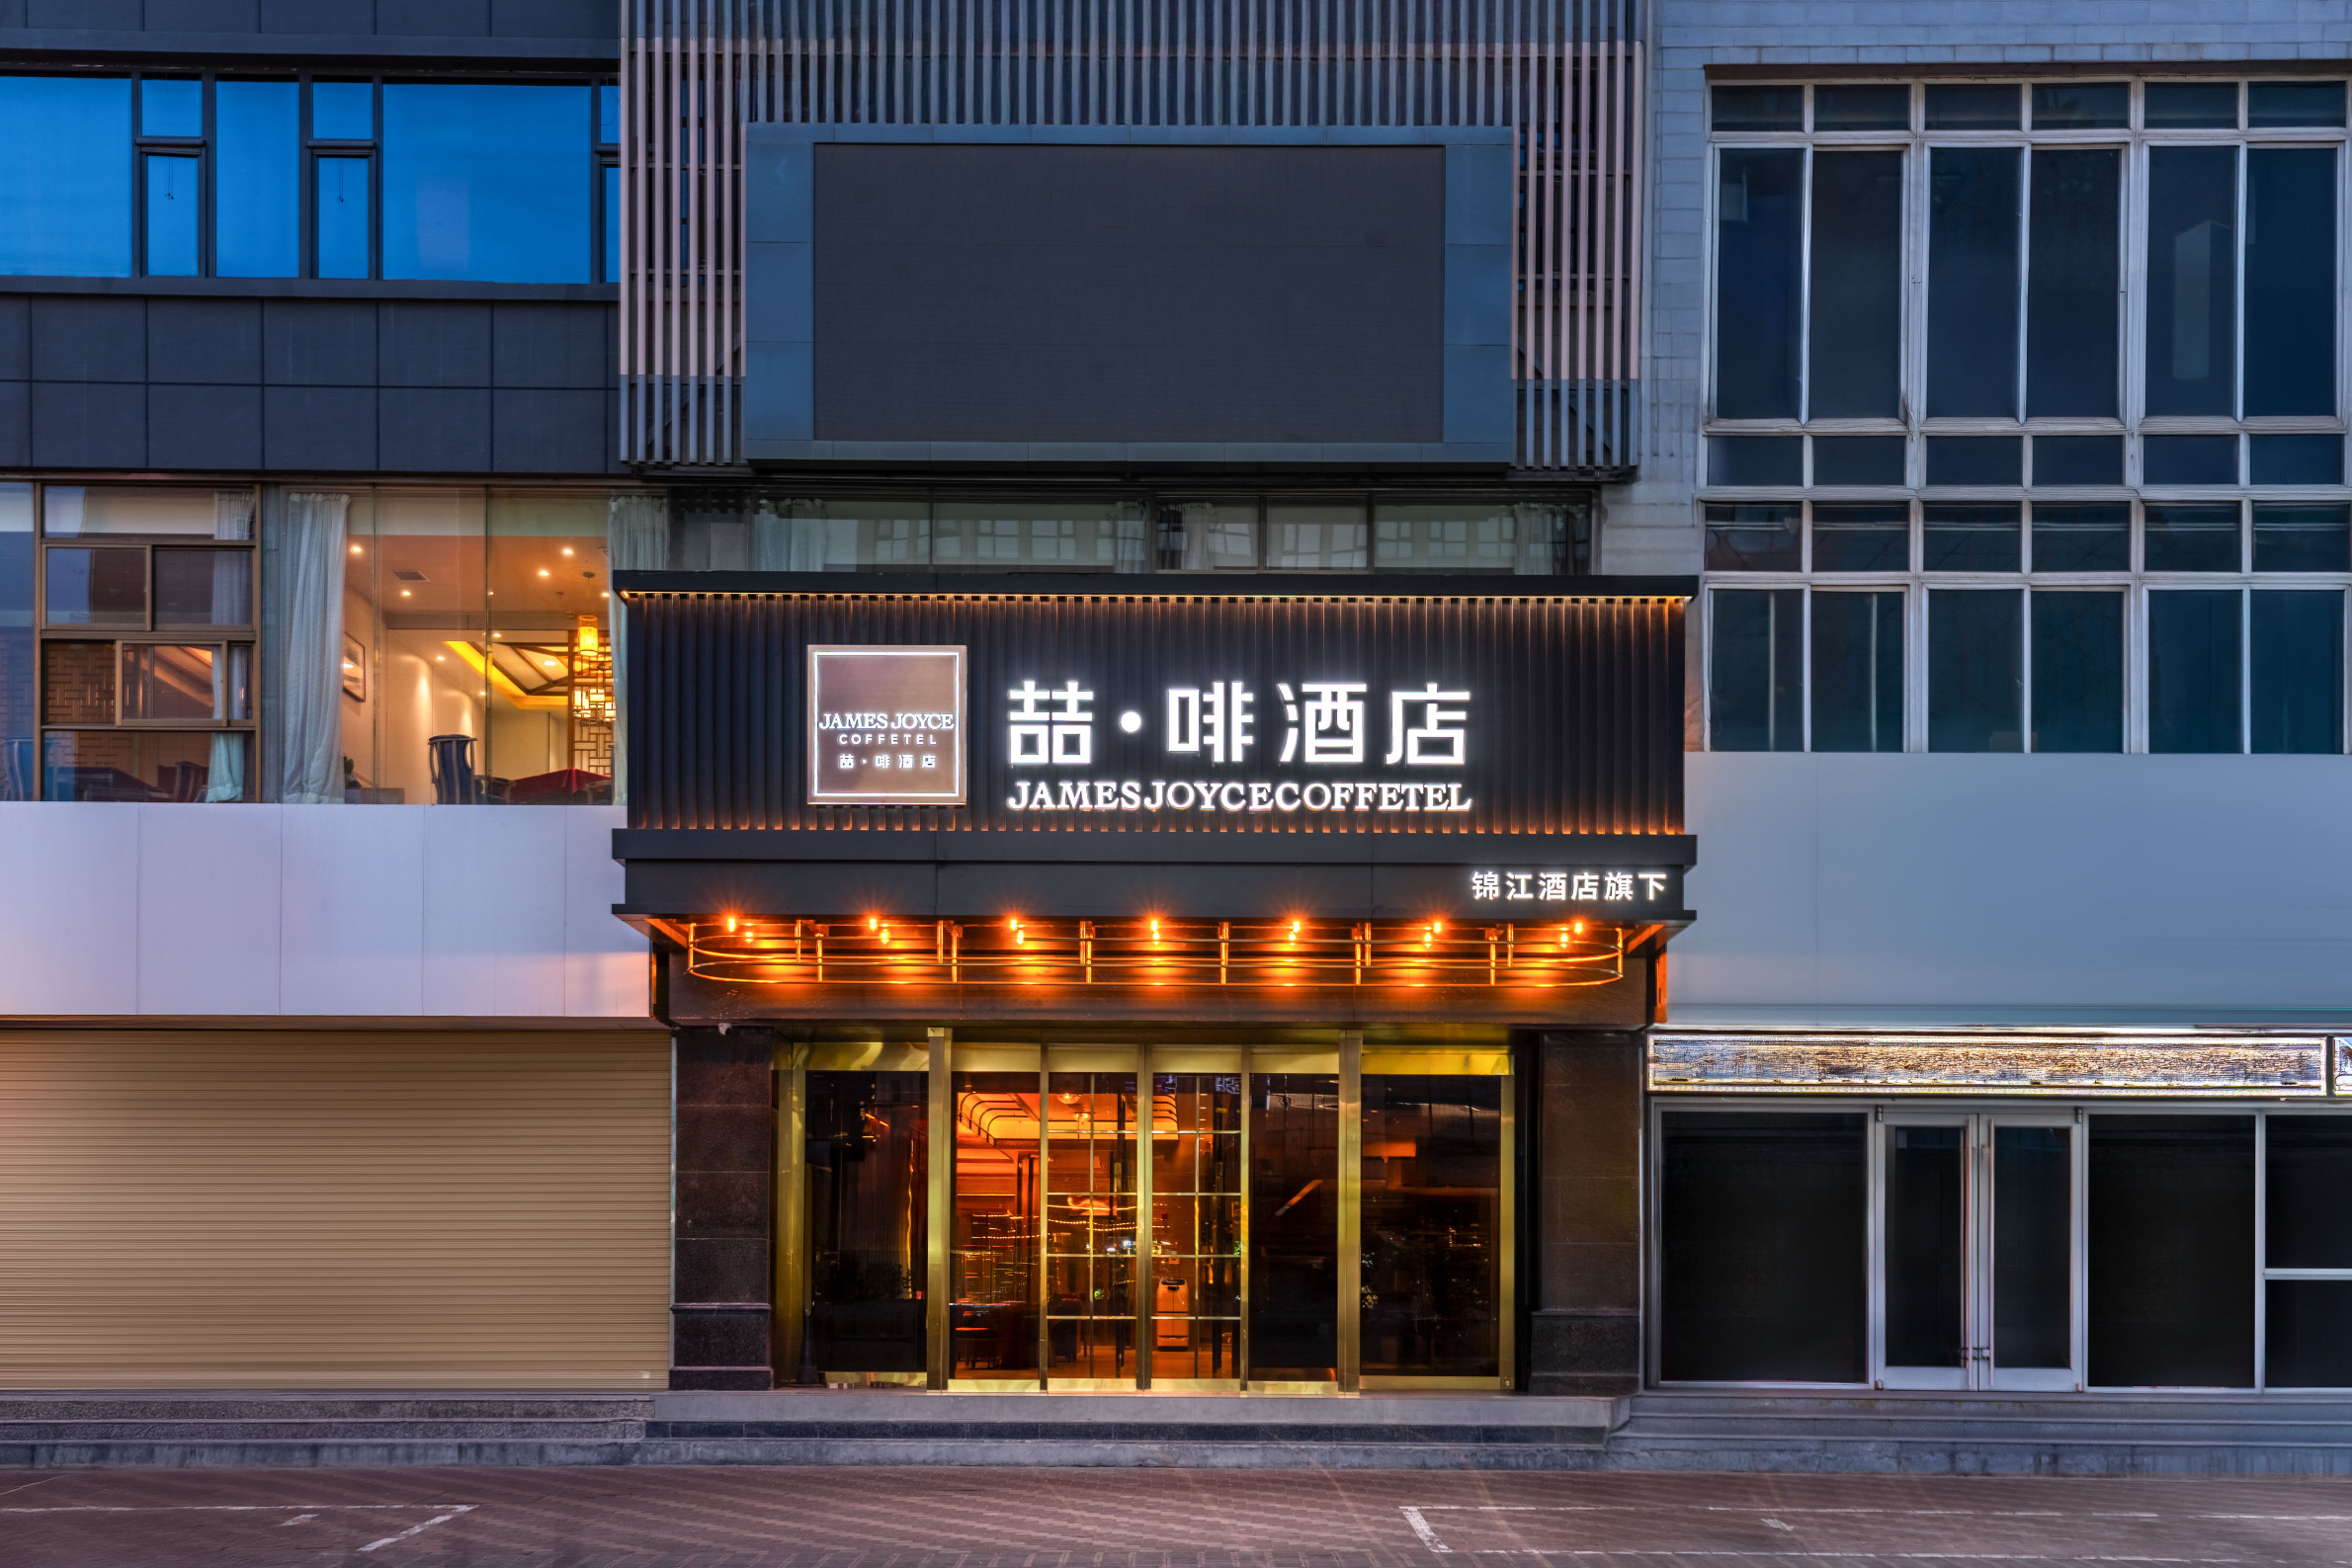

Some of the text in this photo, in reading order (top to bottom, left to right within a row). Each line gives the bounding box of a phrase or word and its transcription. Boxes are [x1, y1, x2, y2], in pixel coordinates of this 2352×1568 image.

[818, 712, 956, 729] JAMES JOYCE
[839, 734, 937, 745] COFFETEL
[1471, 870, 1667, 901] 锦江酒店旗下
